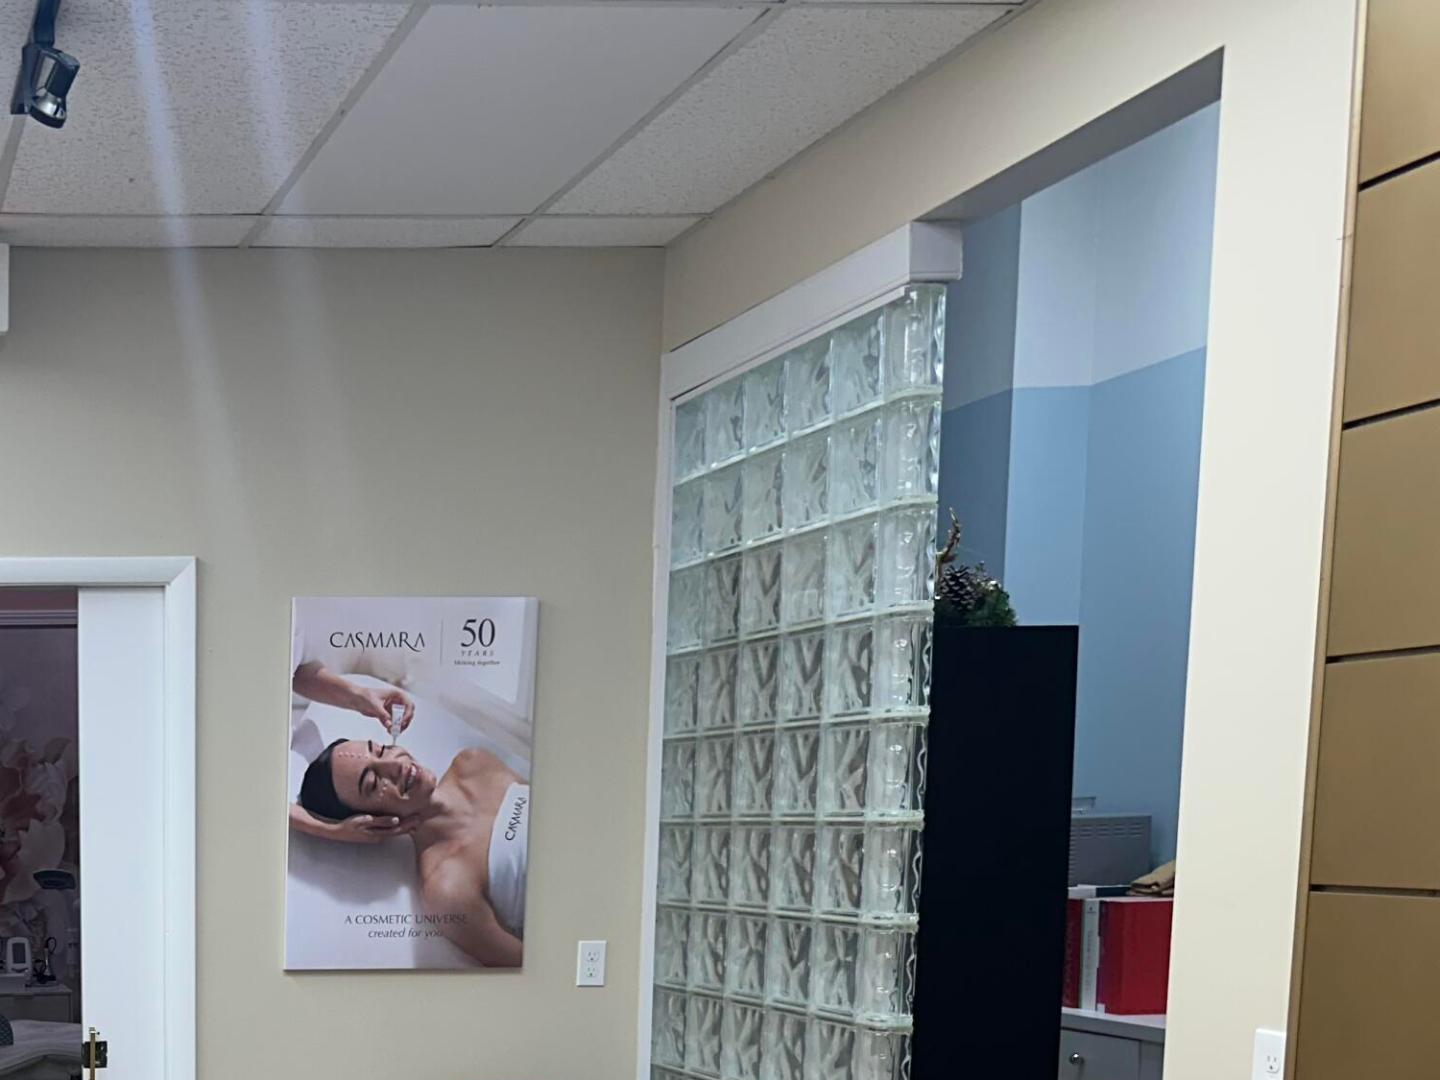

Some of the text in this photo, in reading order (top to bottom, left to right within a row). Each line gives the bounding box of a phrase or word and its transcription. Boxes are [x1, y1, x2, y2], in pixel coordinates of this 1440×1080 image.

[460, 617, 496, 648] 50
[329, 631, 425, 653] CASMARA
[460, 649, 495, 657] YEARS
[504, 796, 528, 841] CASMARA
[344, 913, 467, 926] A COSMETIC UNIVERSE
[367, 926, 444, 939] created for you
